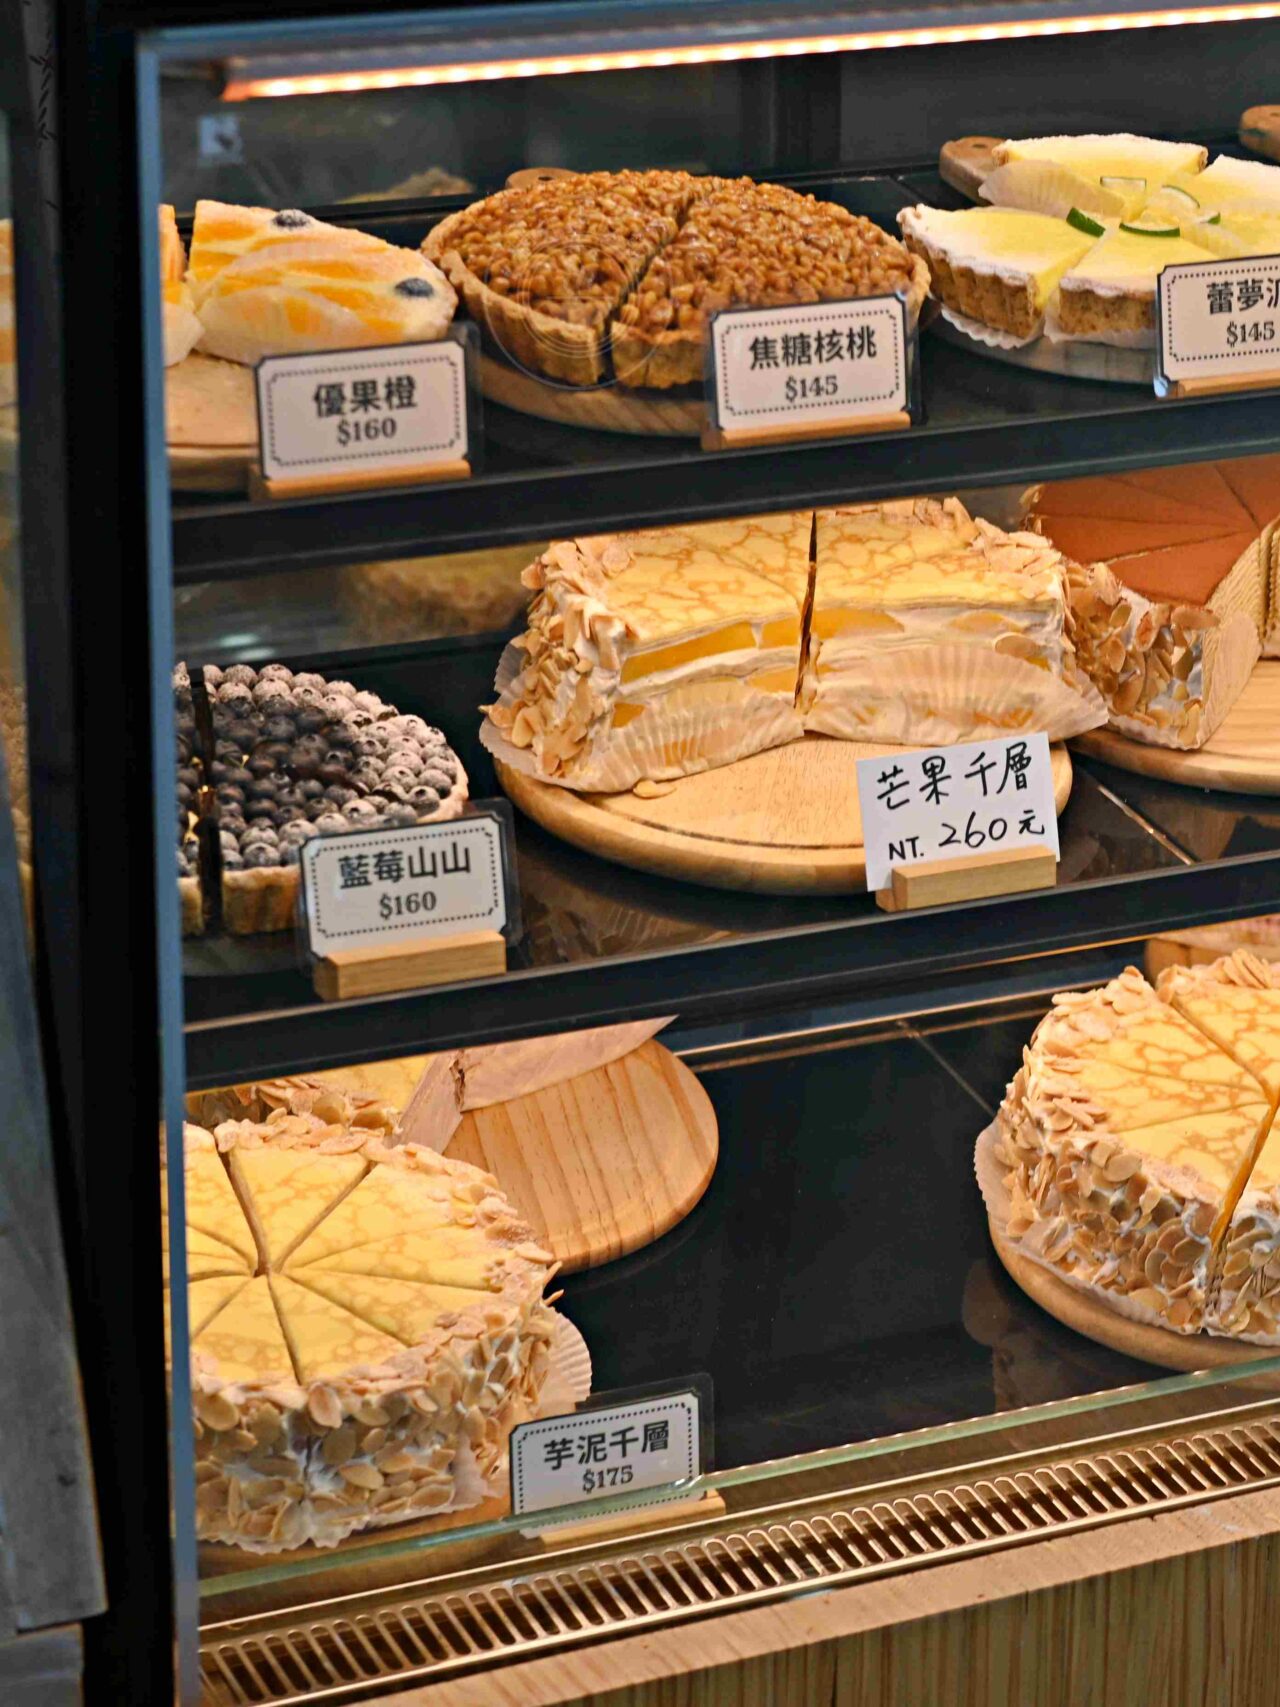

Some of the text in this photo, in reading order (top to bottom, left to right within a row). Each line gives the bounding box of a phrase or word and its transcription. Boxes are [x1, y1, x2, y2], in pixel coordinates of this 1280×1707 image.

[749, 325, 877, 371] 焦糖核桃
[1226, 321, 1275, 347] $145
[314, 375, 417, 418] 優果橙
[785, 375, 838, 402] $145
[337, 418, 397, 446] $160
[877, 741, 1032, 810] 芒果千層
[889, 836, 924, 861] NT.
[338, 841, 471, 889] 藍莓山山
[380, 891, 437, 919] $160
[544, 1420, 669, 1471] 芋泥千層
[582, 1465, 633, 1494] $175
